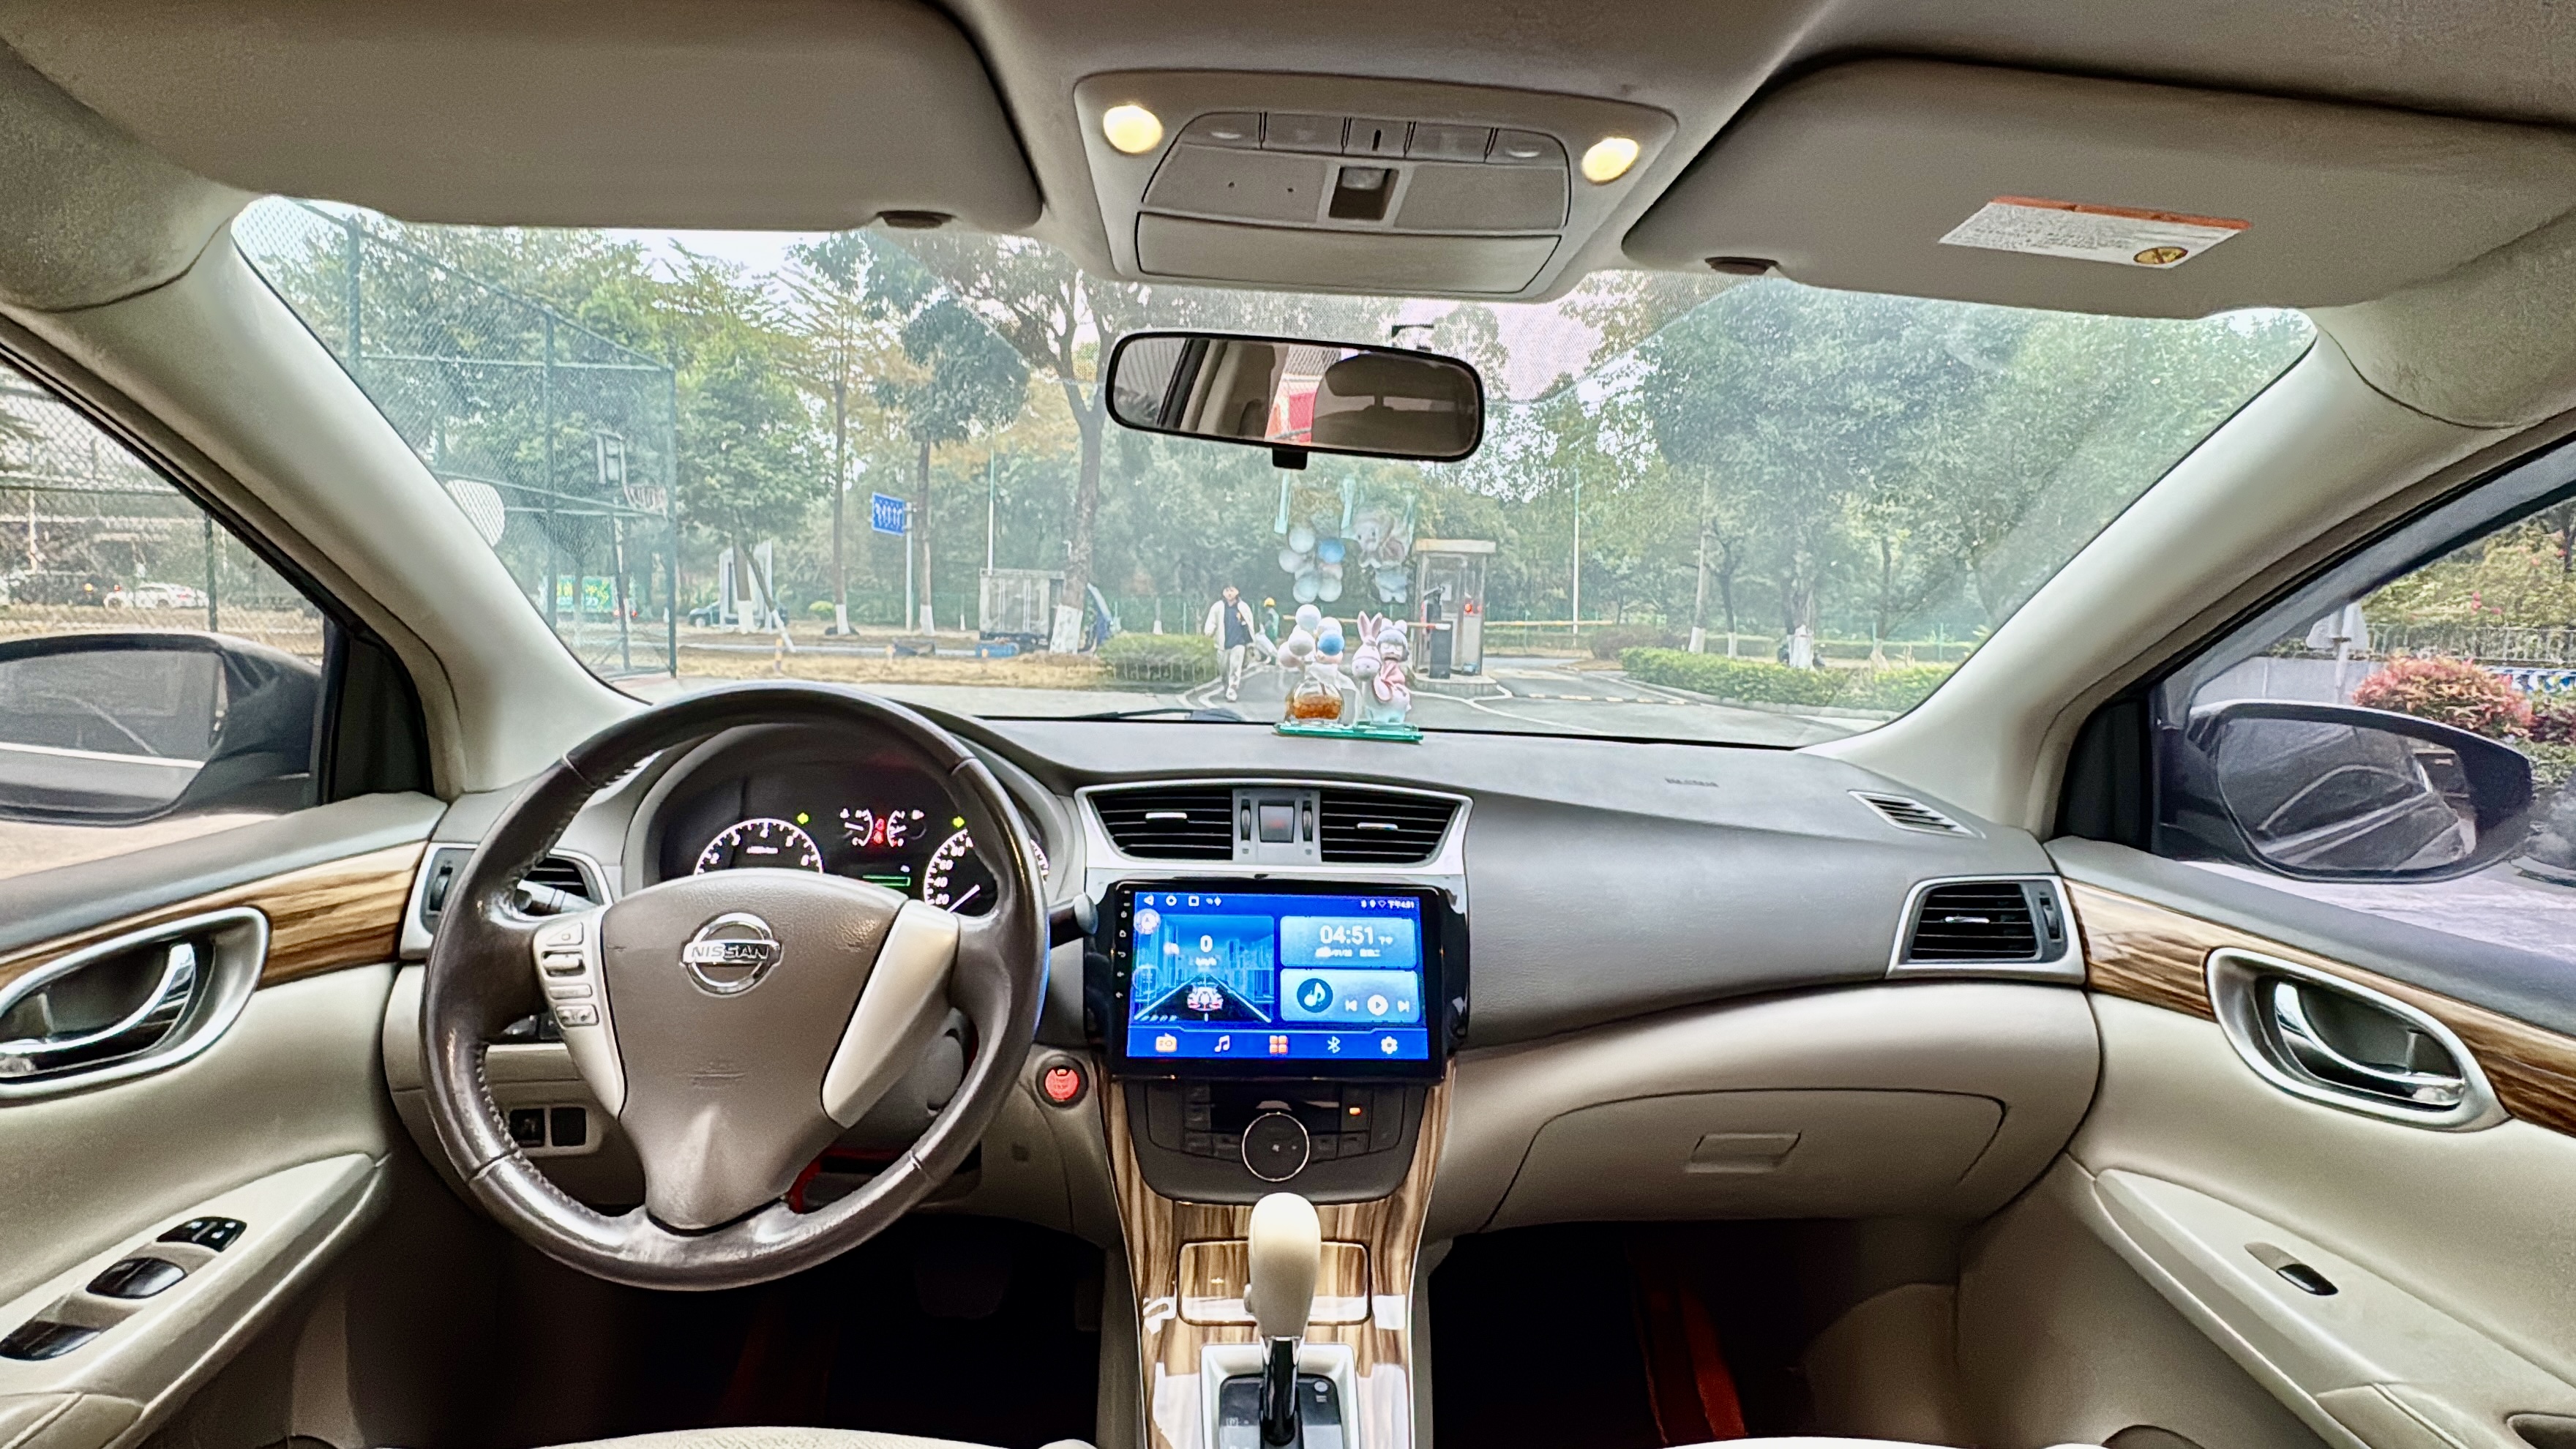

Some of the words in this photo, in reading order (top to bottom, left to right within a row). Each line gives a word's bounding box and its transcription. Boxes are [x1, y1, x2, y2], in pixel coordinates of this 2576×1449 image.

[940, 859, 954, 870] 60
[934, 877, 948, 887] 40
[936, 894, 950, 905] 20
[1319, 925, 1374, 945] 04:51
[1199, 935, 1213, 953] 0
[691, 945, 770, 960] NISSAN
